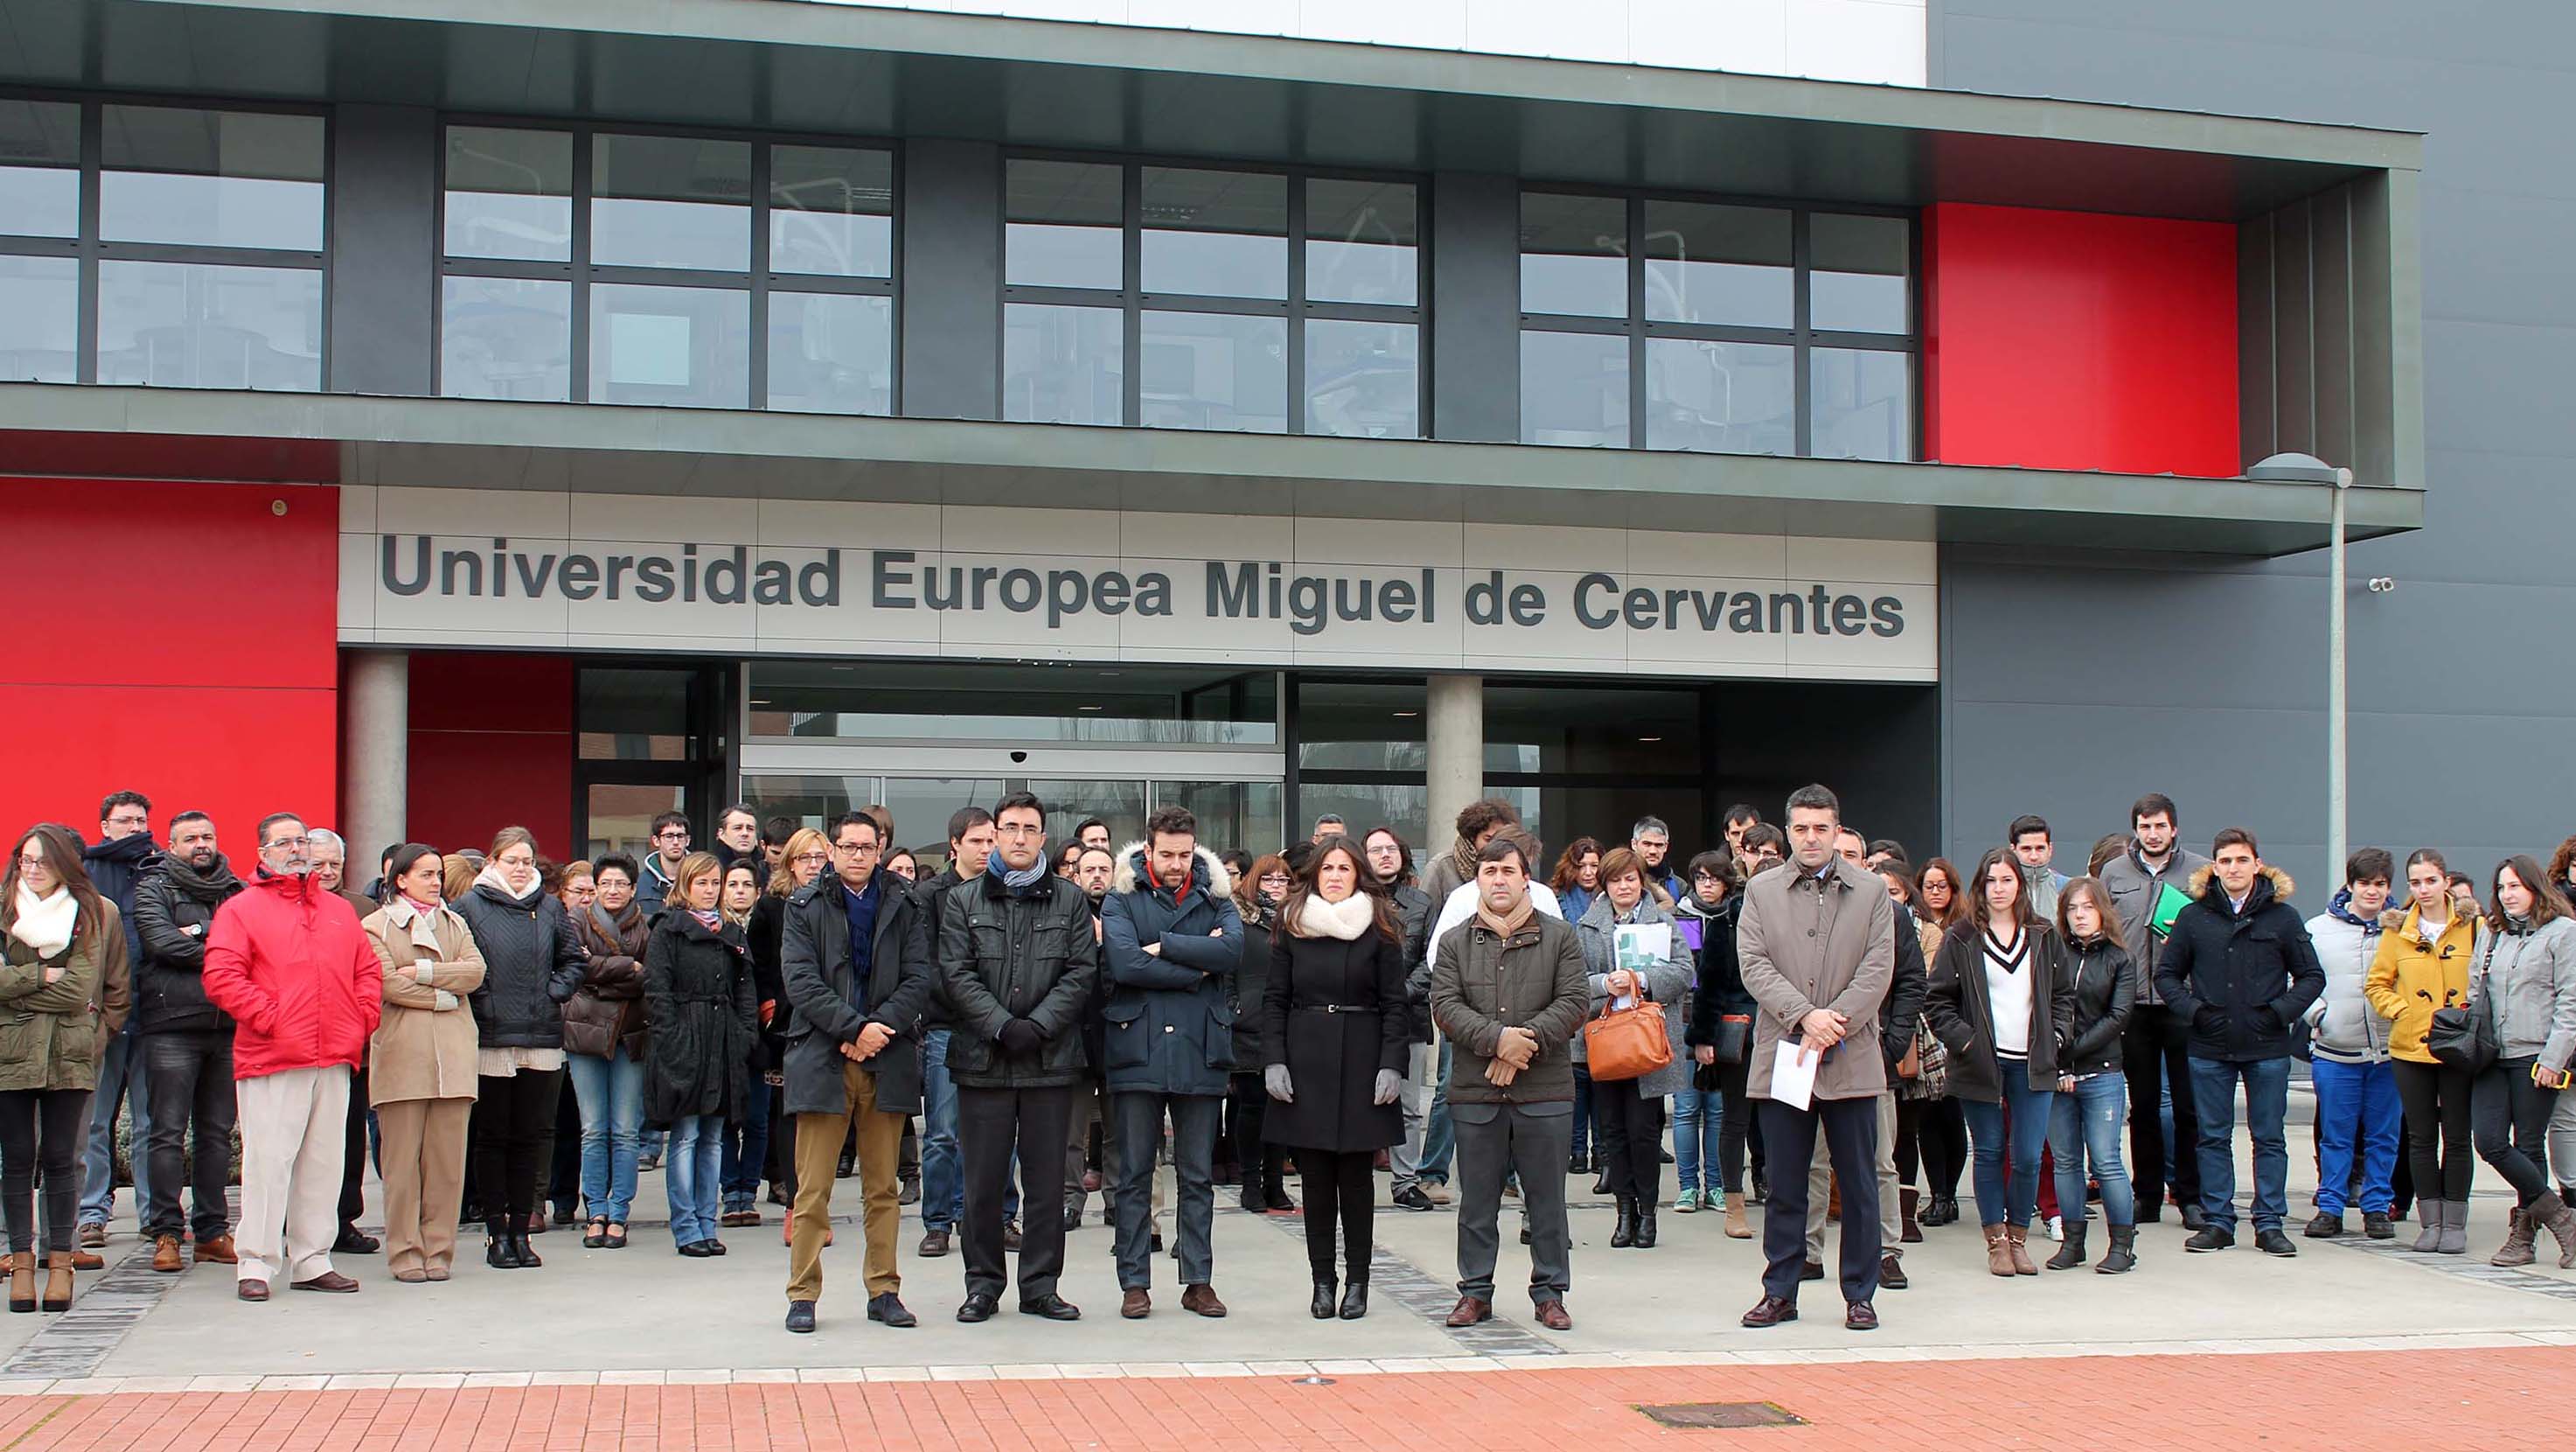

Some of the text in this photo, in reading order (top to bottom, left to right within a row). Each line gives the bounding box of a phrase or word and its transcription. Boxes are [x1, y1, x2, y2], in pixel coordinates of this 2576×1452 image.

[382, 534, 1904, 638] Universidad Europea Miguel de Cervantes
